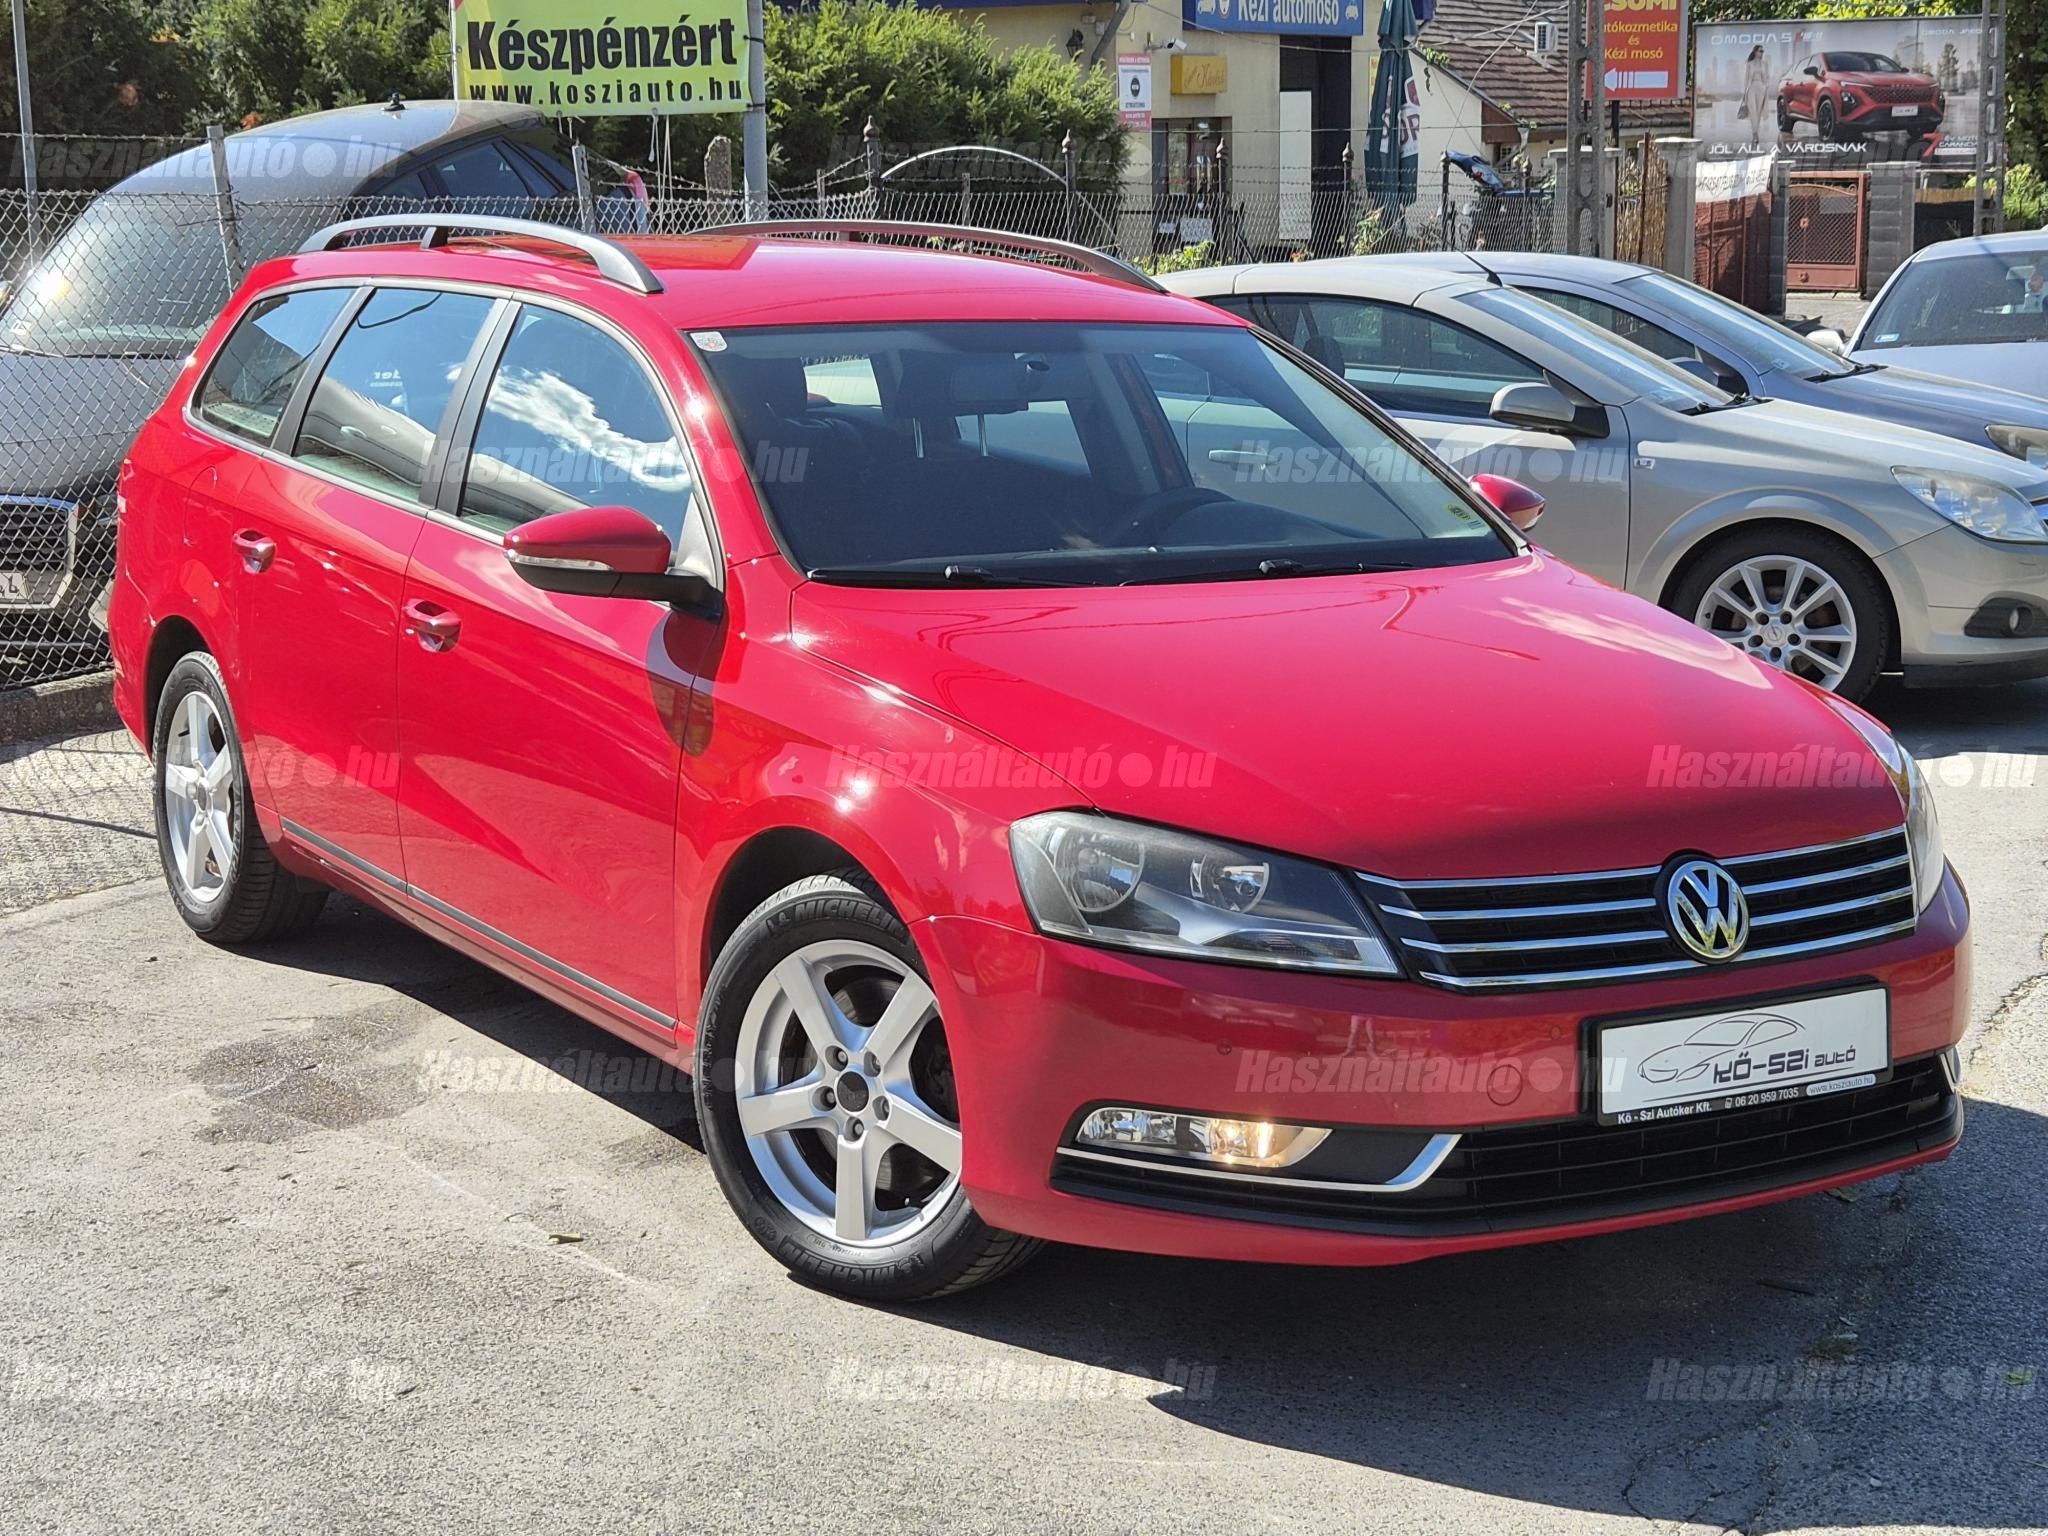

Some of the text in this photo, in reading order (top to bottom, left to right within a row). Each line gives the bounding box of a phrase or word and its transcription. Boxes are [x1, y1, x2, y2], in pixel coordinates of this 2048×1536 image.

[1604, 20, 1678, 33] tókozmetika
[467, 14, 737, 75] Készpénzért
[1628, 35, 1640, 46] és
[1605, 46, 1664, 60] Kézi mosó
[469, 77, 743, 105] www.kosziauto.hu
[1709, 143, 1733, 154] JÓL
[1737, 143, 1765, 154] ÁLL
[1786, 142, 1867, 153] VÁROSNAK
[795, 898, 908, 944] MICHELIN
[1640, 1109, 1655, 1121] Szi
[1656, 1104, 1694, 1119] Autóker
[1735, 1096, 1747, 1107] 06
[1749, 1094, 1760, 1105] 20
[1761, 1092, 1777, 1103] 959
[1779, 1087, 1799, 1099] 7035
